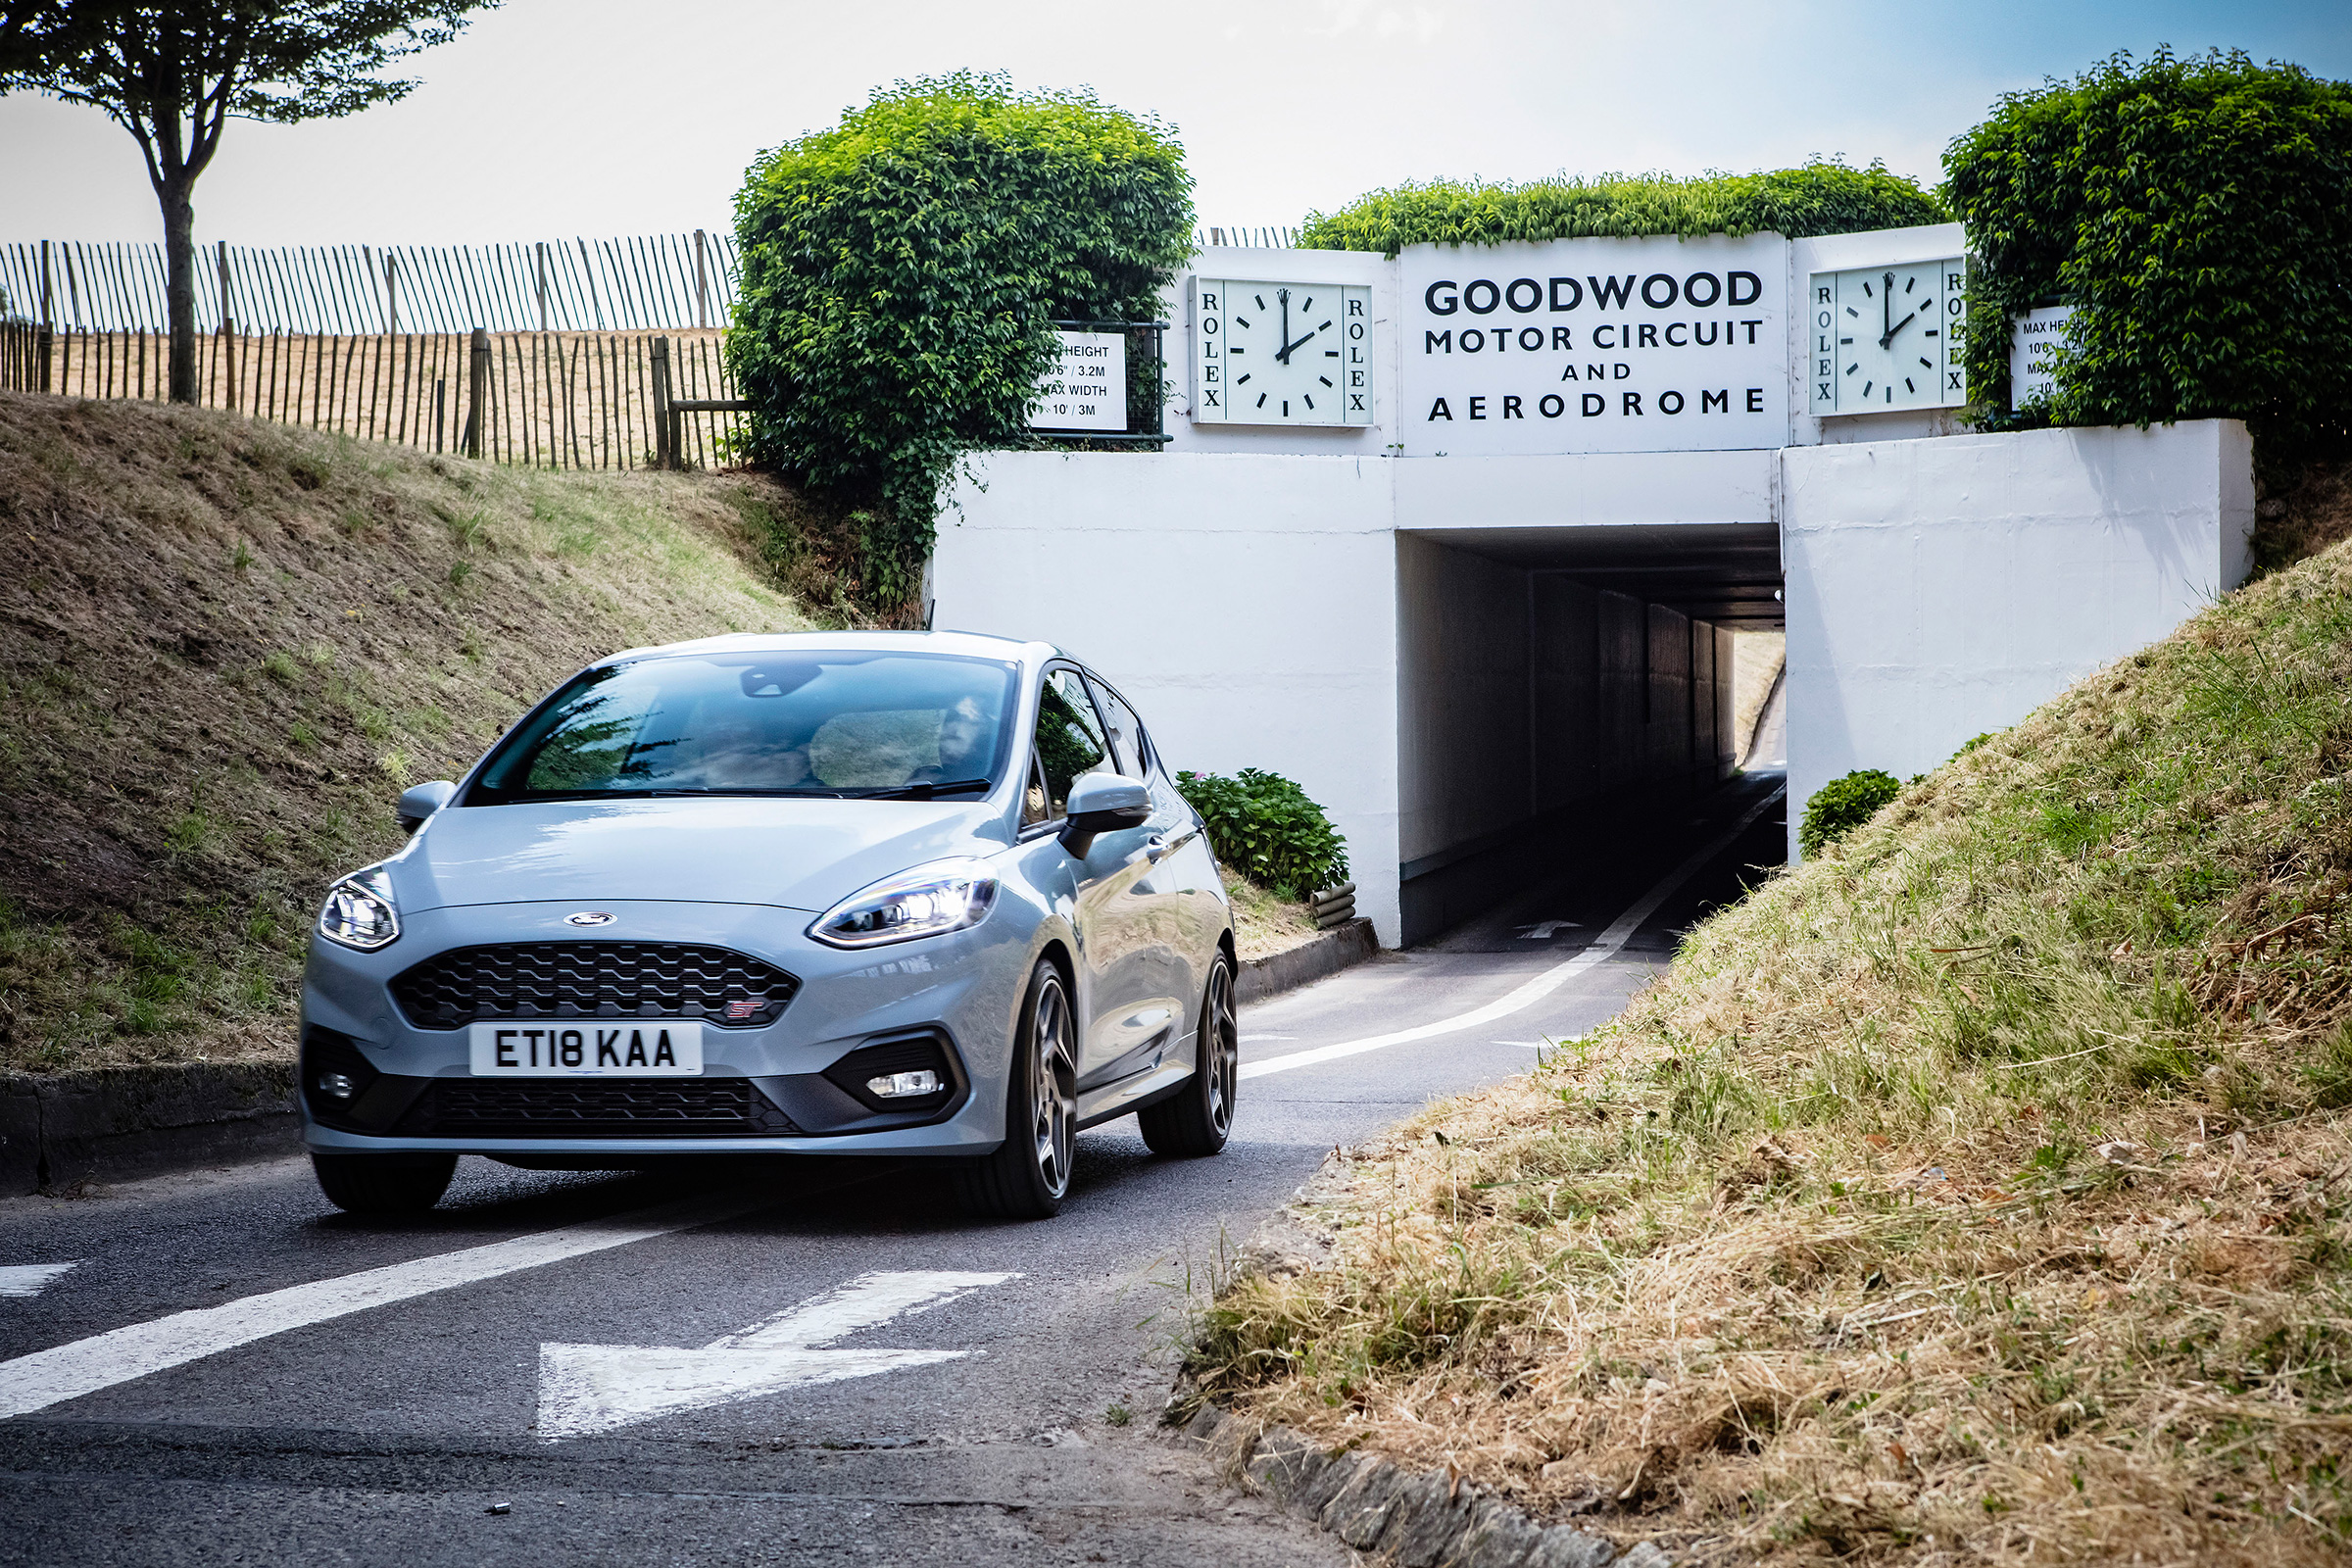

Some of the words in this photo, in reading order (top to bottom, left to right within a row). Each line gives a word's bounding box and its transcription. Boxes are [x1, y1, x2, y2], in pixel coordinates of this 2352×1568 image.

[1425, 270, 1762, 316] GOODWOOD
[1425, 325, 1572, 355] MOTOR
[1592, 319, 1763, 349] CIRCUIT
[1818, 287, 1832, 401] ROLEX
[1947, 272, 1962, 389] ROLEX
[2023, 321, 2046, 334] MAX
[1065, 345, 1109, 357] HEIGHT
[1201, 293, 1220, 407] ROLEX
[1348, 299, 1365, 412] ROLEX
[1070, 365, 1075, 377] /
[1078, 365, 1105, 377] 3.2M
[1561, 363, 1631, 381] AND
[1068, 385, 1107, 396] WIDTH
[1428, 388, 1764, 421] AERODROME
[1053, 403, 1068, 415] 10'
[1078, 404, 1096, 416] 3M
[727, 1000, 764, 1018] ST
[495, 1029, 583, 1067] ET18
[597, 1029, 677, 1067] KAA
